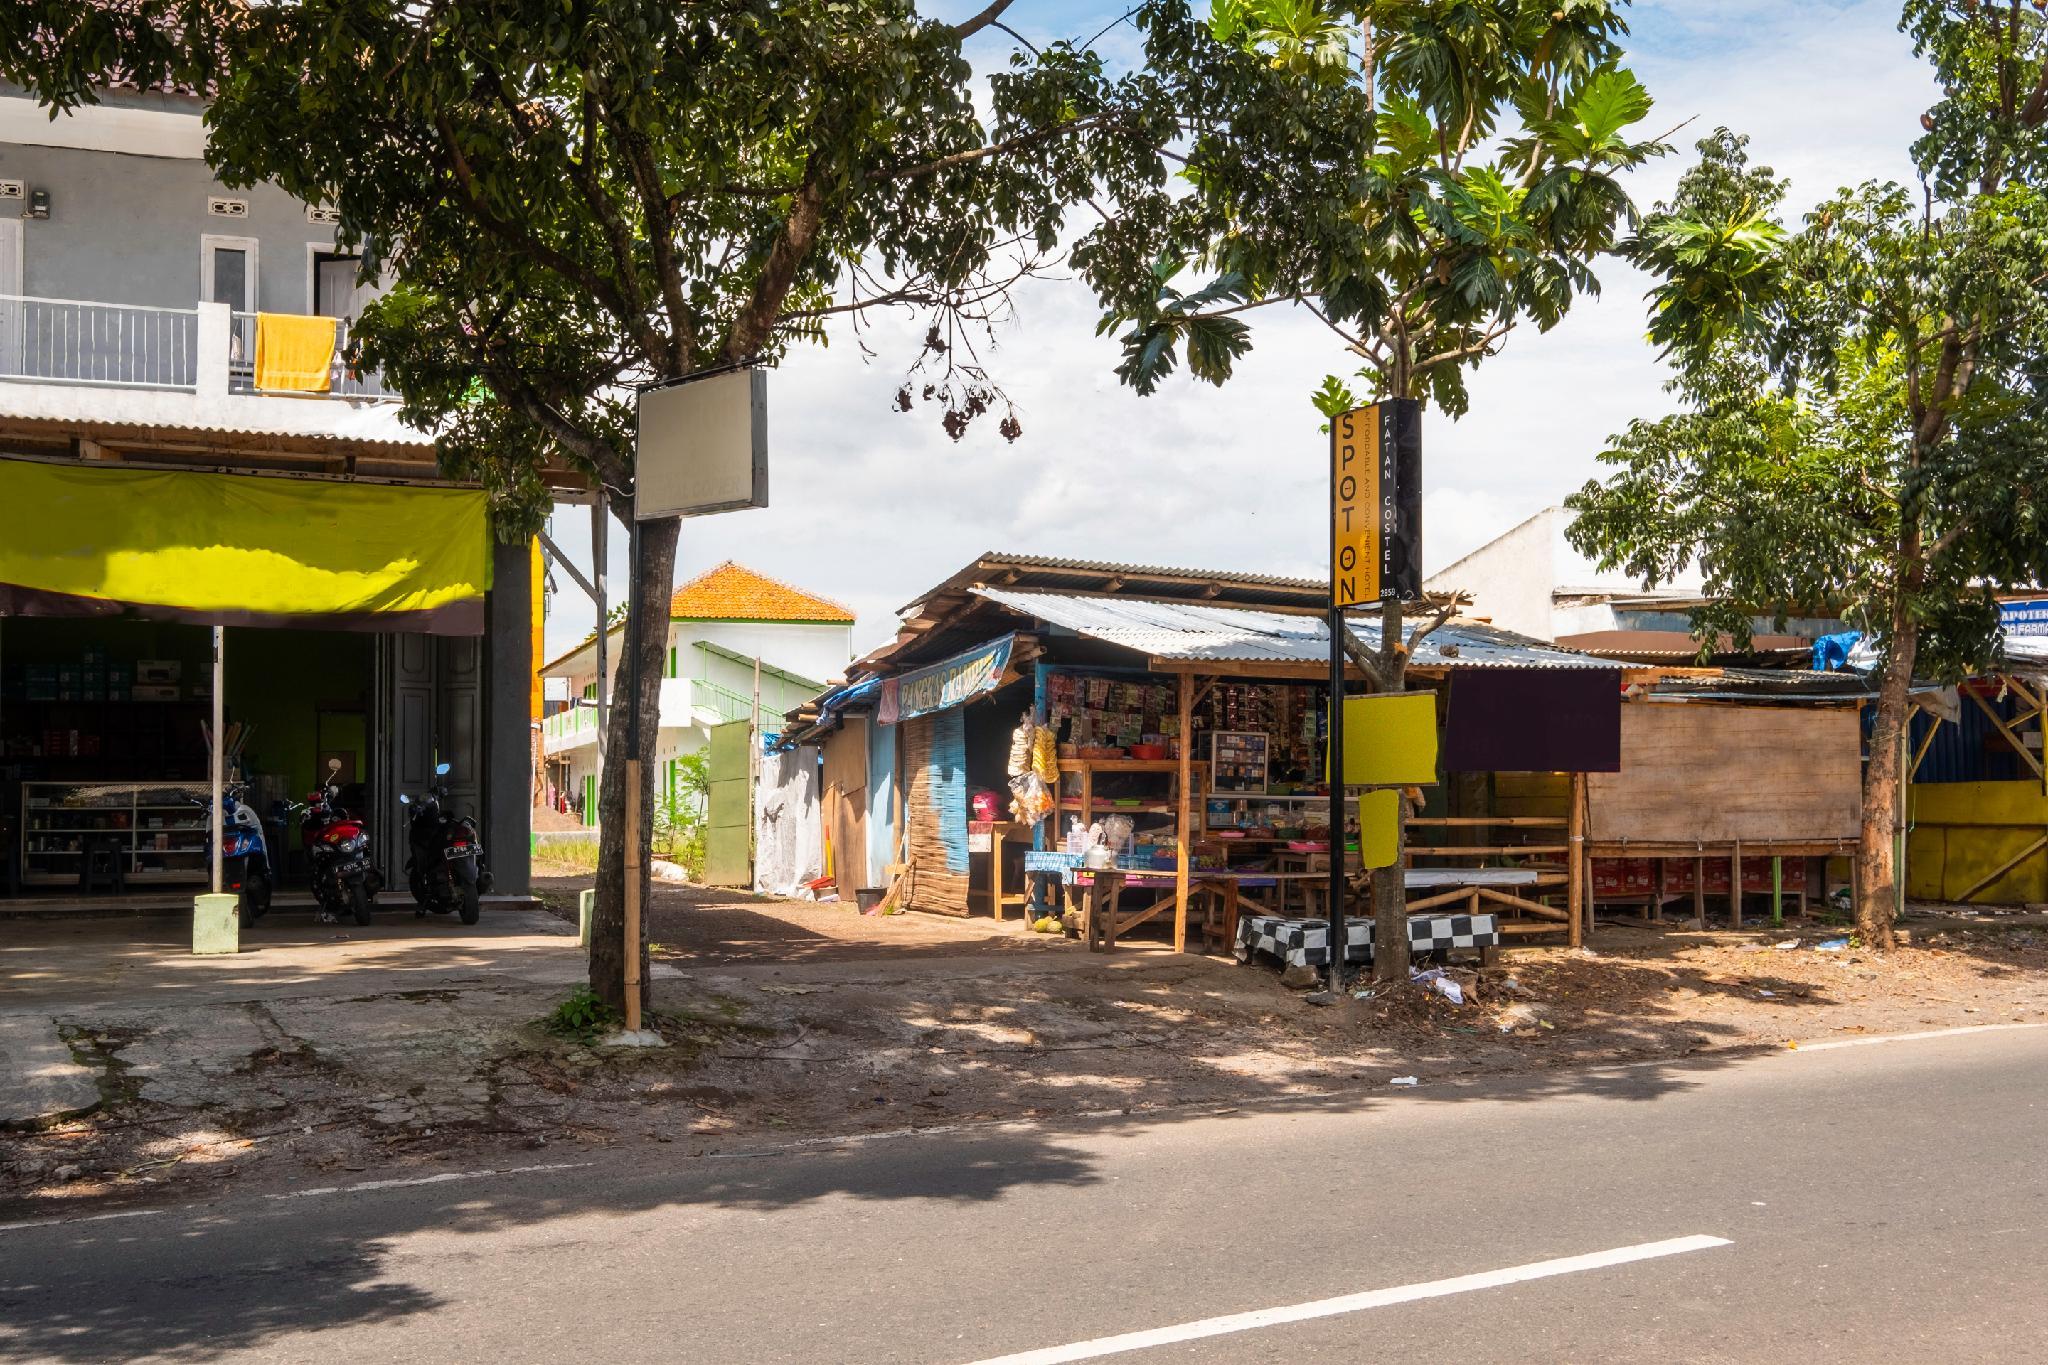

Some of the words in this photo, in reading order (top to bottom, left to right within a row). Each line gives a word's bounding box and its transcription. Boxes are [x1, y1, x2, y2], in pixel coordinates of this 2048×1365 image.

[1339, 414, 1357, 533] SPOT
[1364, 478, 1372, 499] AND
[1339, 546, 1357, 604] ON
